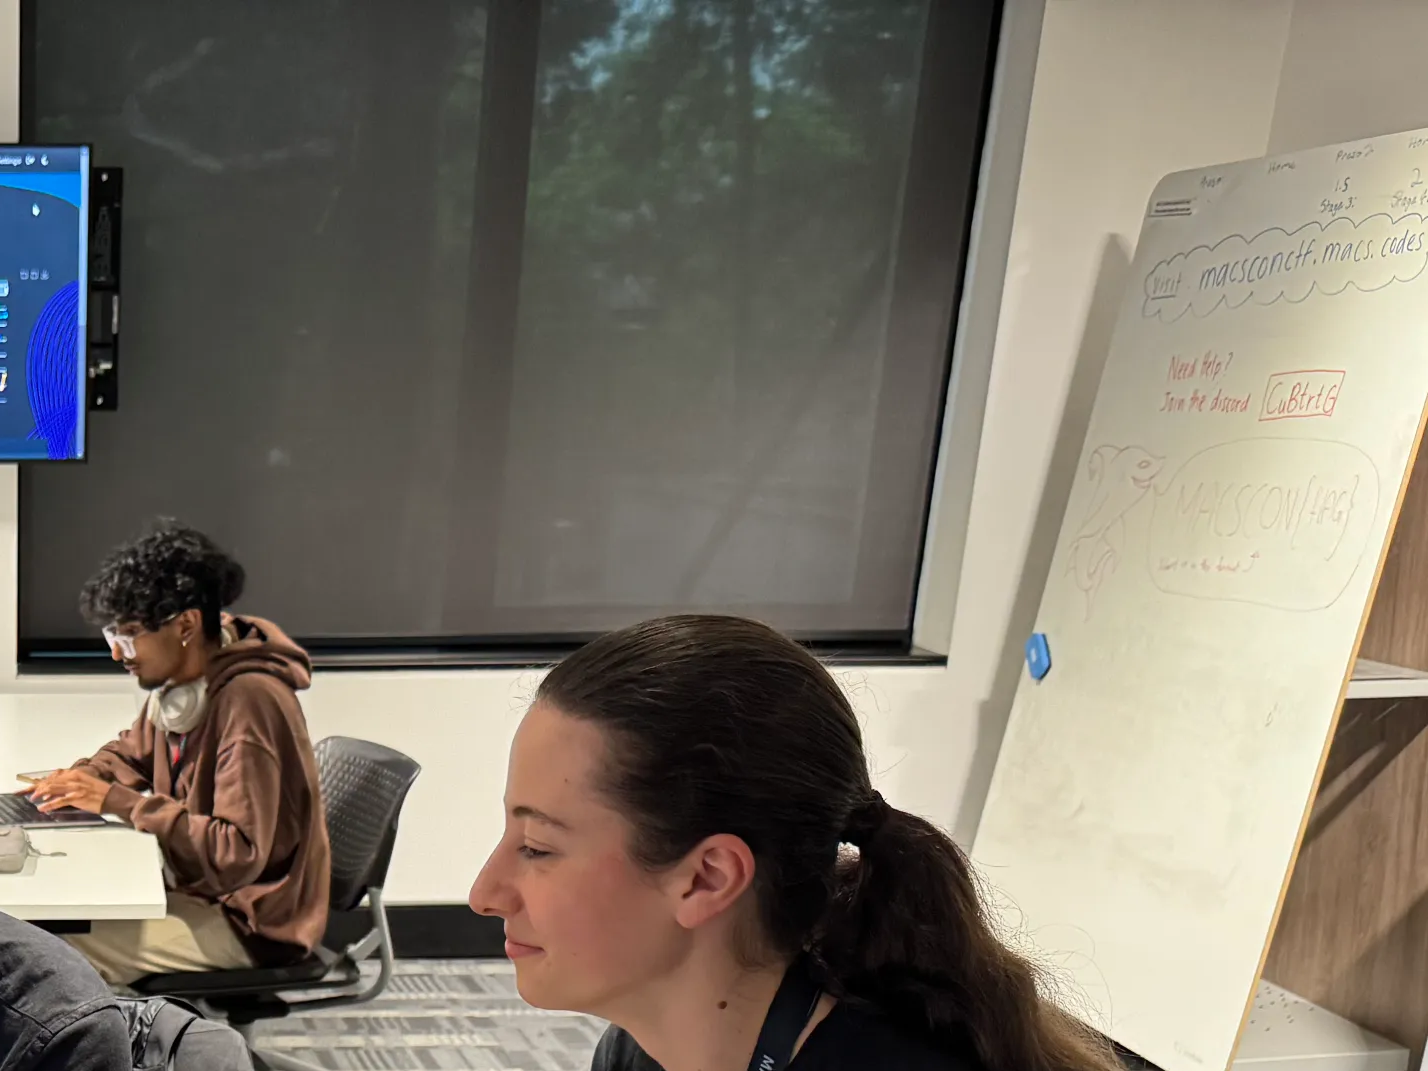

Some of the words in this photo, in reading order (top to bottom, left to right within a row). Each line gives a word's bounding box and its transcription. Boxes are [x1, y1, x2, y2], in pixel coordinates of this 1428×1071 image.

[1167, 356, 1198, 381] Need
[1160, 392, 1185, 412] Join
[1188, 389, 1205, 412] the
[1210, 389, 1252, 413] discord
